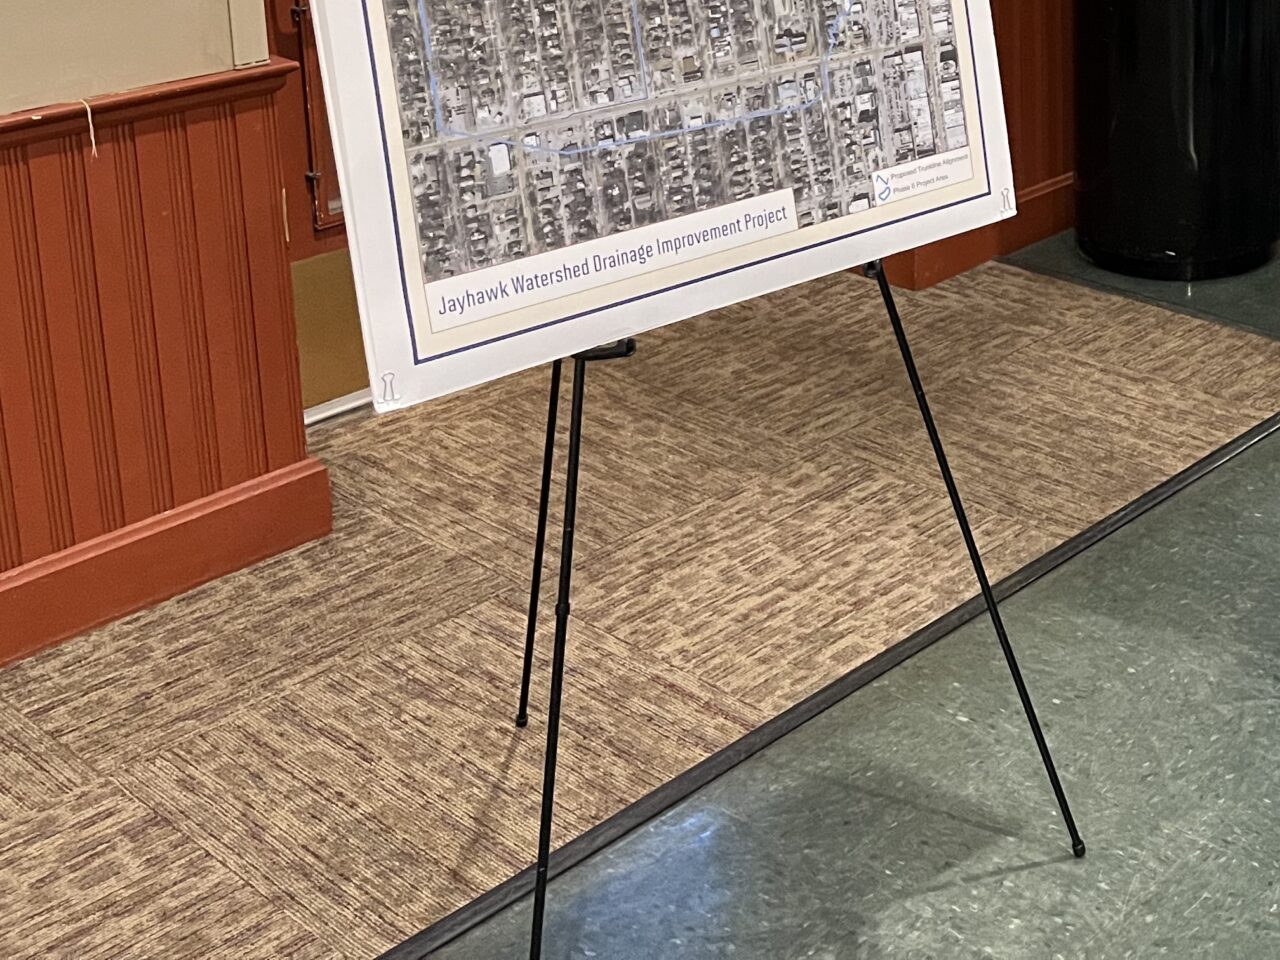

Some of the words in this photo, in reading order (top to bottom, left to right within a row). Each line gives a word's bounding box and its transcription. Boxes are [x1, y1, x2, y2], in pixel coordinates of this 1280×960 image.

[438, 281, 509, 316] Jayhawk
[511, 257, 591, 294] Watershed
[593, 246, 655, 273] Drainage
[656, 222, 743, 256] Improvement
[744, 205, 788, 232] Project
